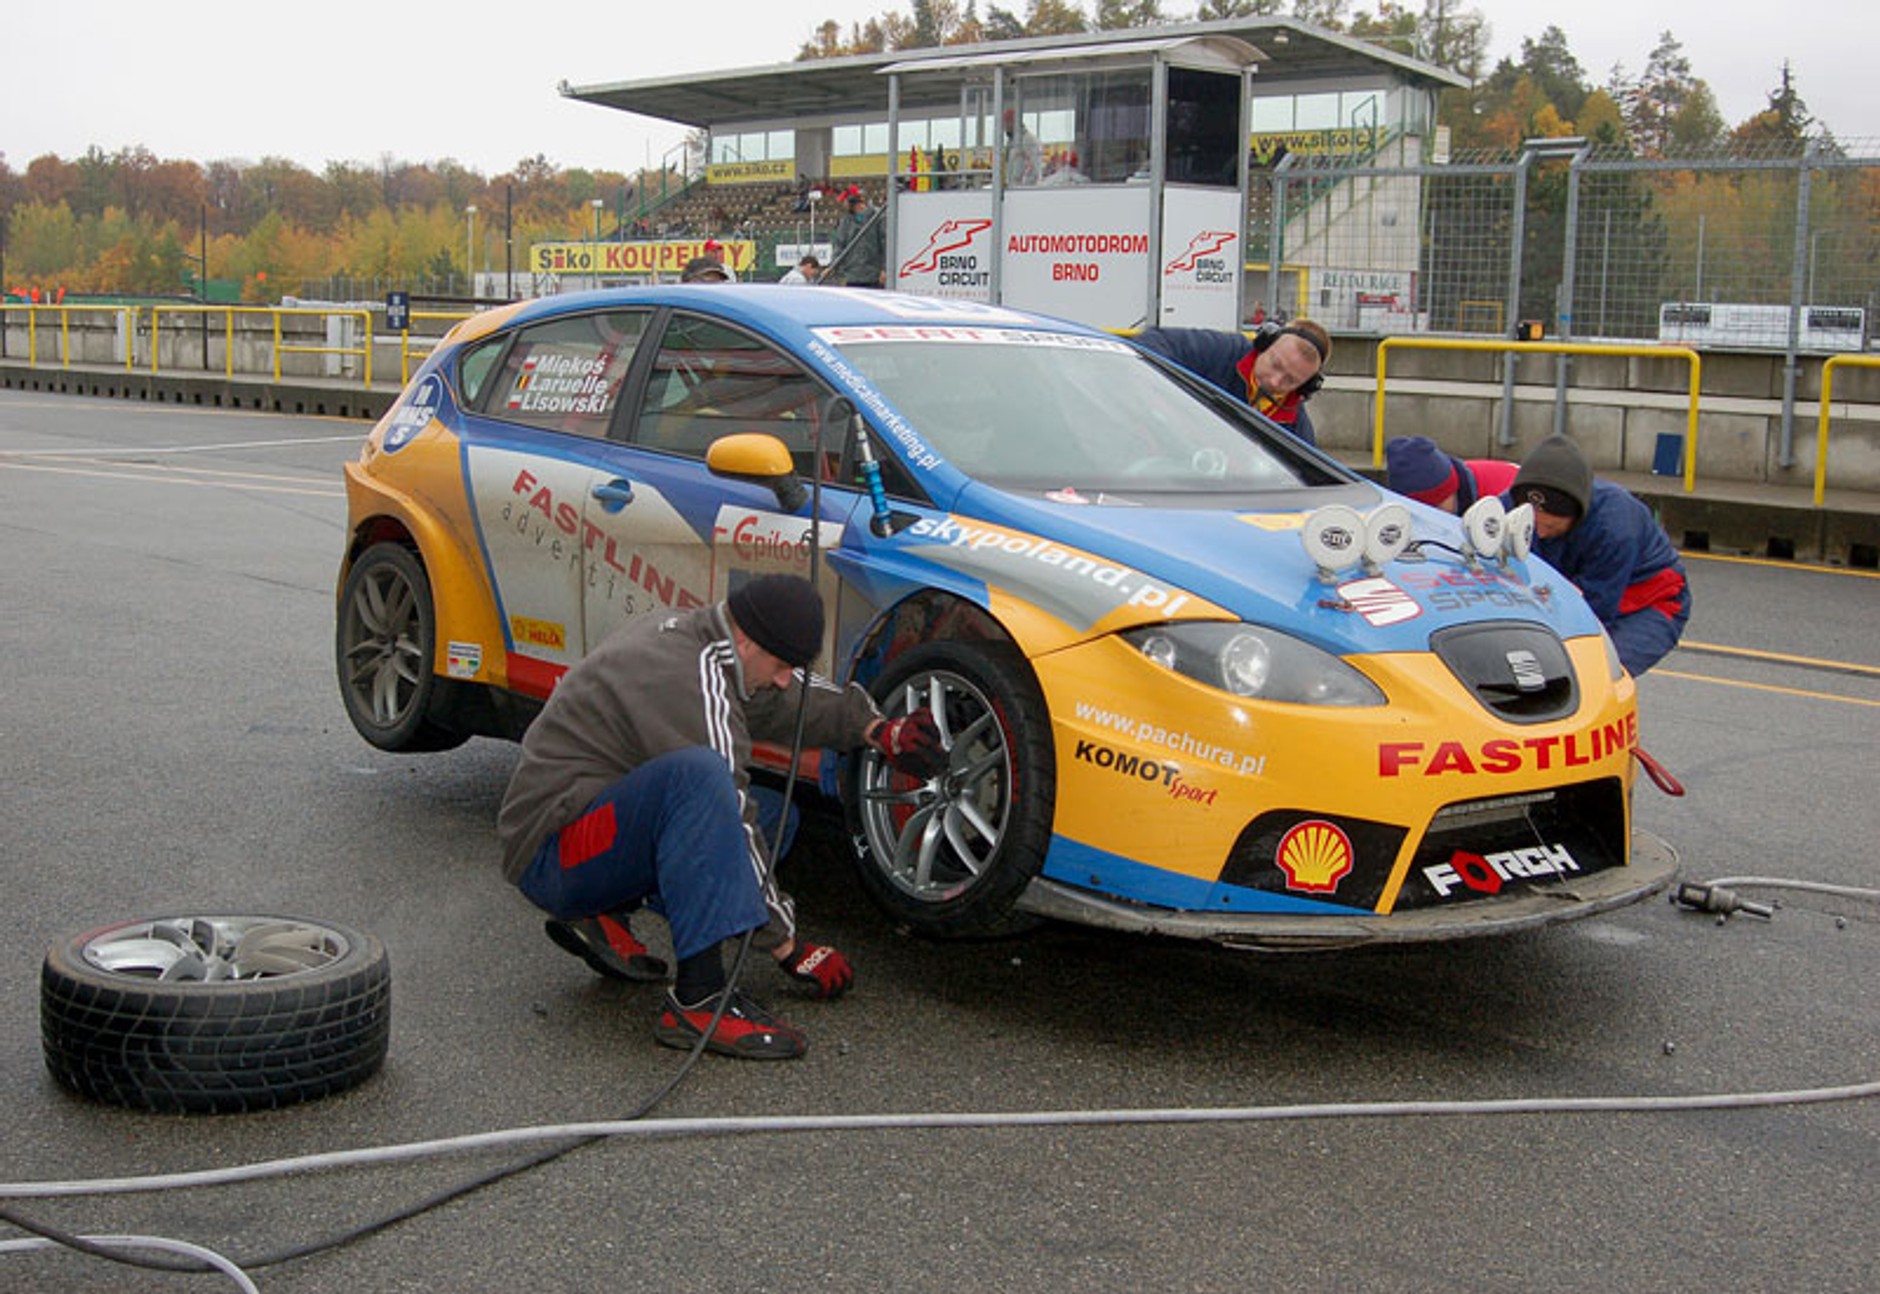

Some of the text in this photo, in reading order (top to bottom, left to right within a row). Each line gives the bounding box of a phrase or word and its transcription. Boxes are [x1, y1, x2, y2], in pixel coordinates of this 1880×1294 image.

[1008, 234, 1149, 255] AUTOMOTODROM
[538, 249, 592, 271] Siko
[939, 255, 977, 271] BRNO
[1196, 258, 1226, 272] BRNO
[937, 271, 989, 286] CIRCUIT
[1052, 262, 1099, 282] BRNO
[1196, 271, 1233, 284] CIRCUIT
[831, 327, 983, 342] SEAT
[528, 374, 609, 395] Laruelle
[521, 391, 610, 414] Lisowski
[807, 339, 943, 472] www.medicalmarketing.pl
[512, 468, 706, 611] FASTLINE
[502, 500, 656, 616] advertis
[909, 517, 1190, 619] skypoland.pl
[1074, 700, 1267, 777] www.pachura.pl
[1378, 711, 1638, 778] FASTLINE
[1074, 739, 1180, 787] KOMOT
